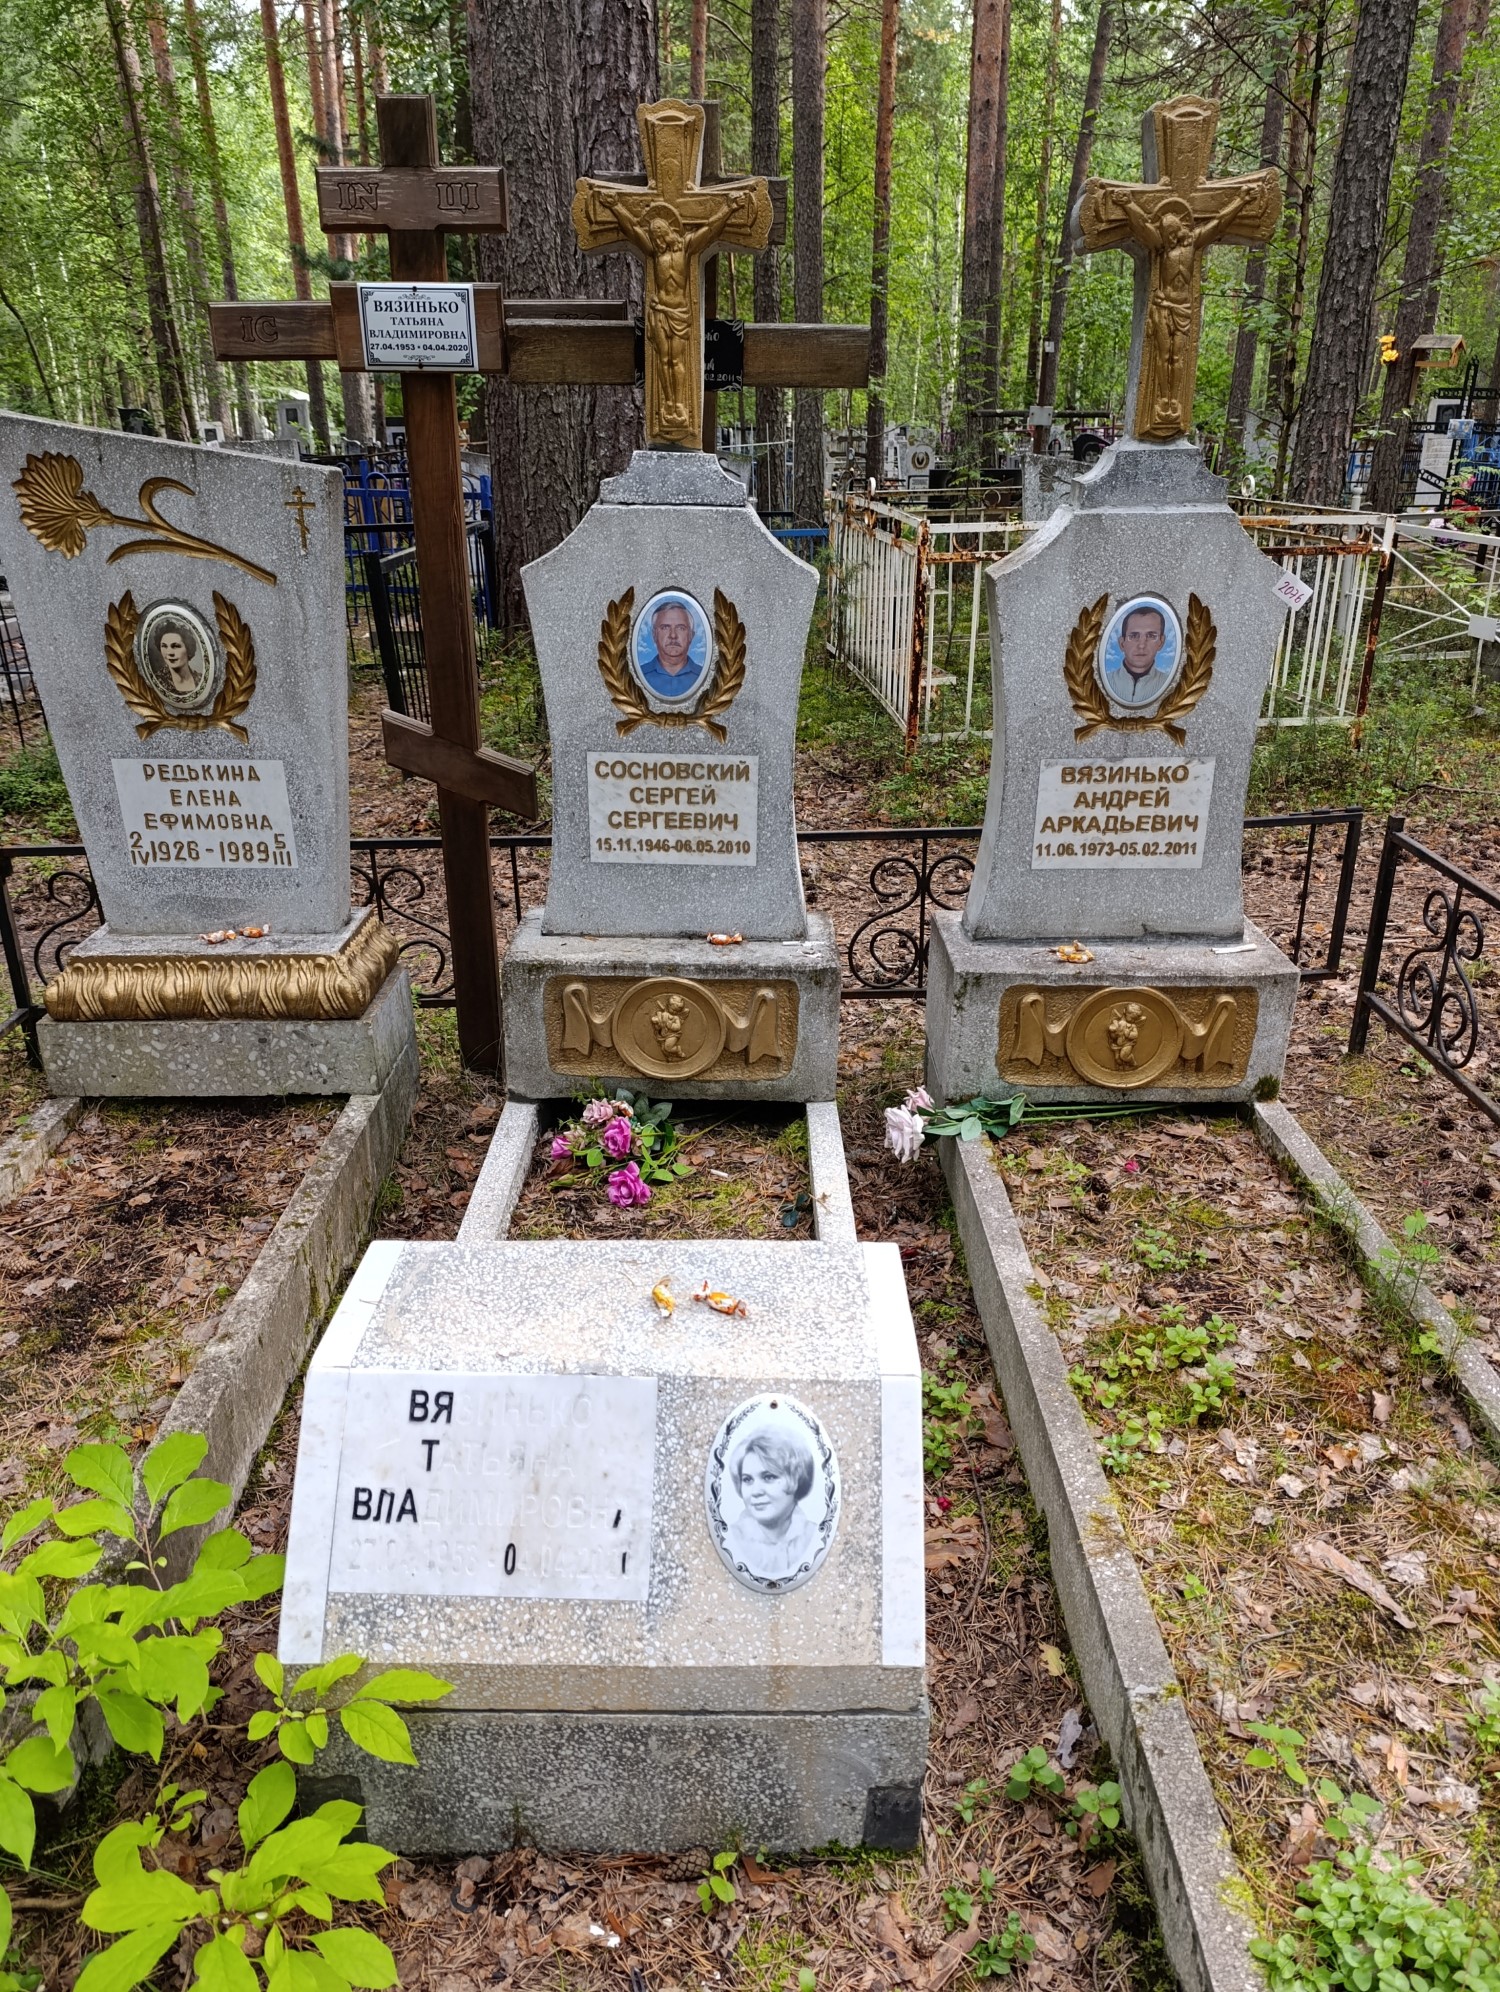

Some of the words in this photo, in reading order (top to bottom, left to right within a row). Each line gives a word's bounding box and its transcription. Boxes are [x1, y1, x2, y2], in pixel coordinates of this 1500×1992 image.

[373, 300, 459, 314] ВЯЗИНЬКО
[389, 316, 445, 327] ТАТЬЯНА
[369, 329, 467, 340] ВЛАДИМИРОВНА
[370, 343, 416, 351] 27.04.1953
[142, 763, 261, 783] РЕДЬКИНА
[594, 760, 750, 782] СОСНОВСКИЙ
[1060, 764, 1190, 785] ВЯЗИНЬКО
[170, 788, 242, 808] ЕЛЕНА
[629, 784, 717, 806] СЕРГЕЙ
[1073, 786, 1170, 812] АНДРЕЙ
[143, 812, 274, 831] ЕФИМОВНА
[607, 810, 739, 832] СЕРГЕЕВИЧ
[1039, 814, 1199, 835] АРКАДЬЕВИЧ
